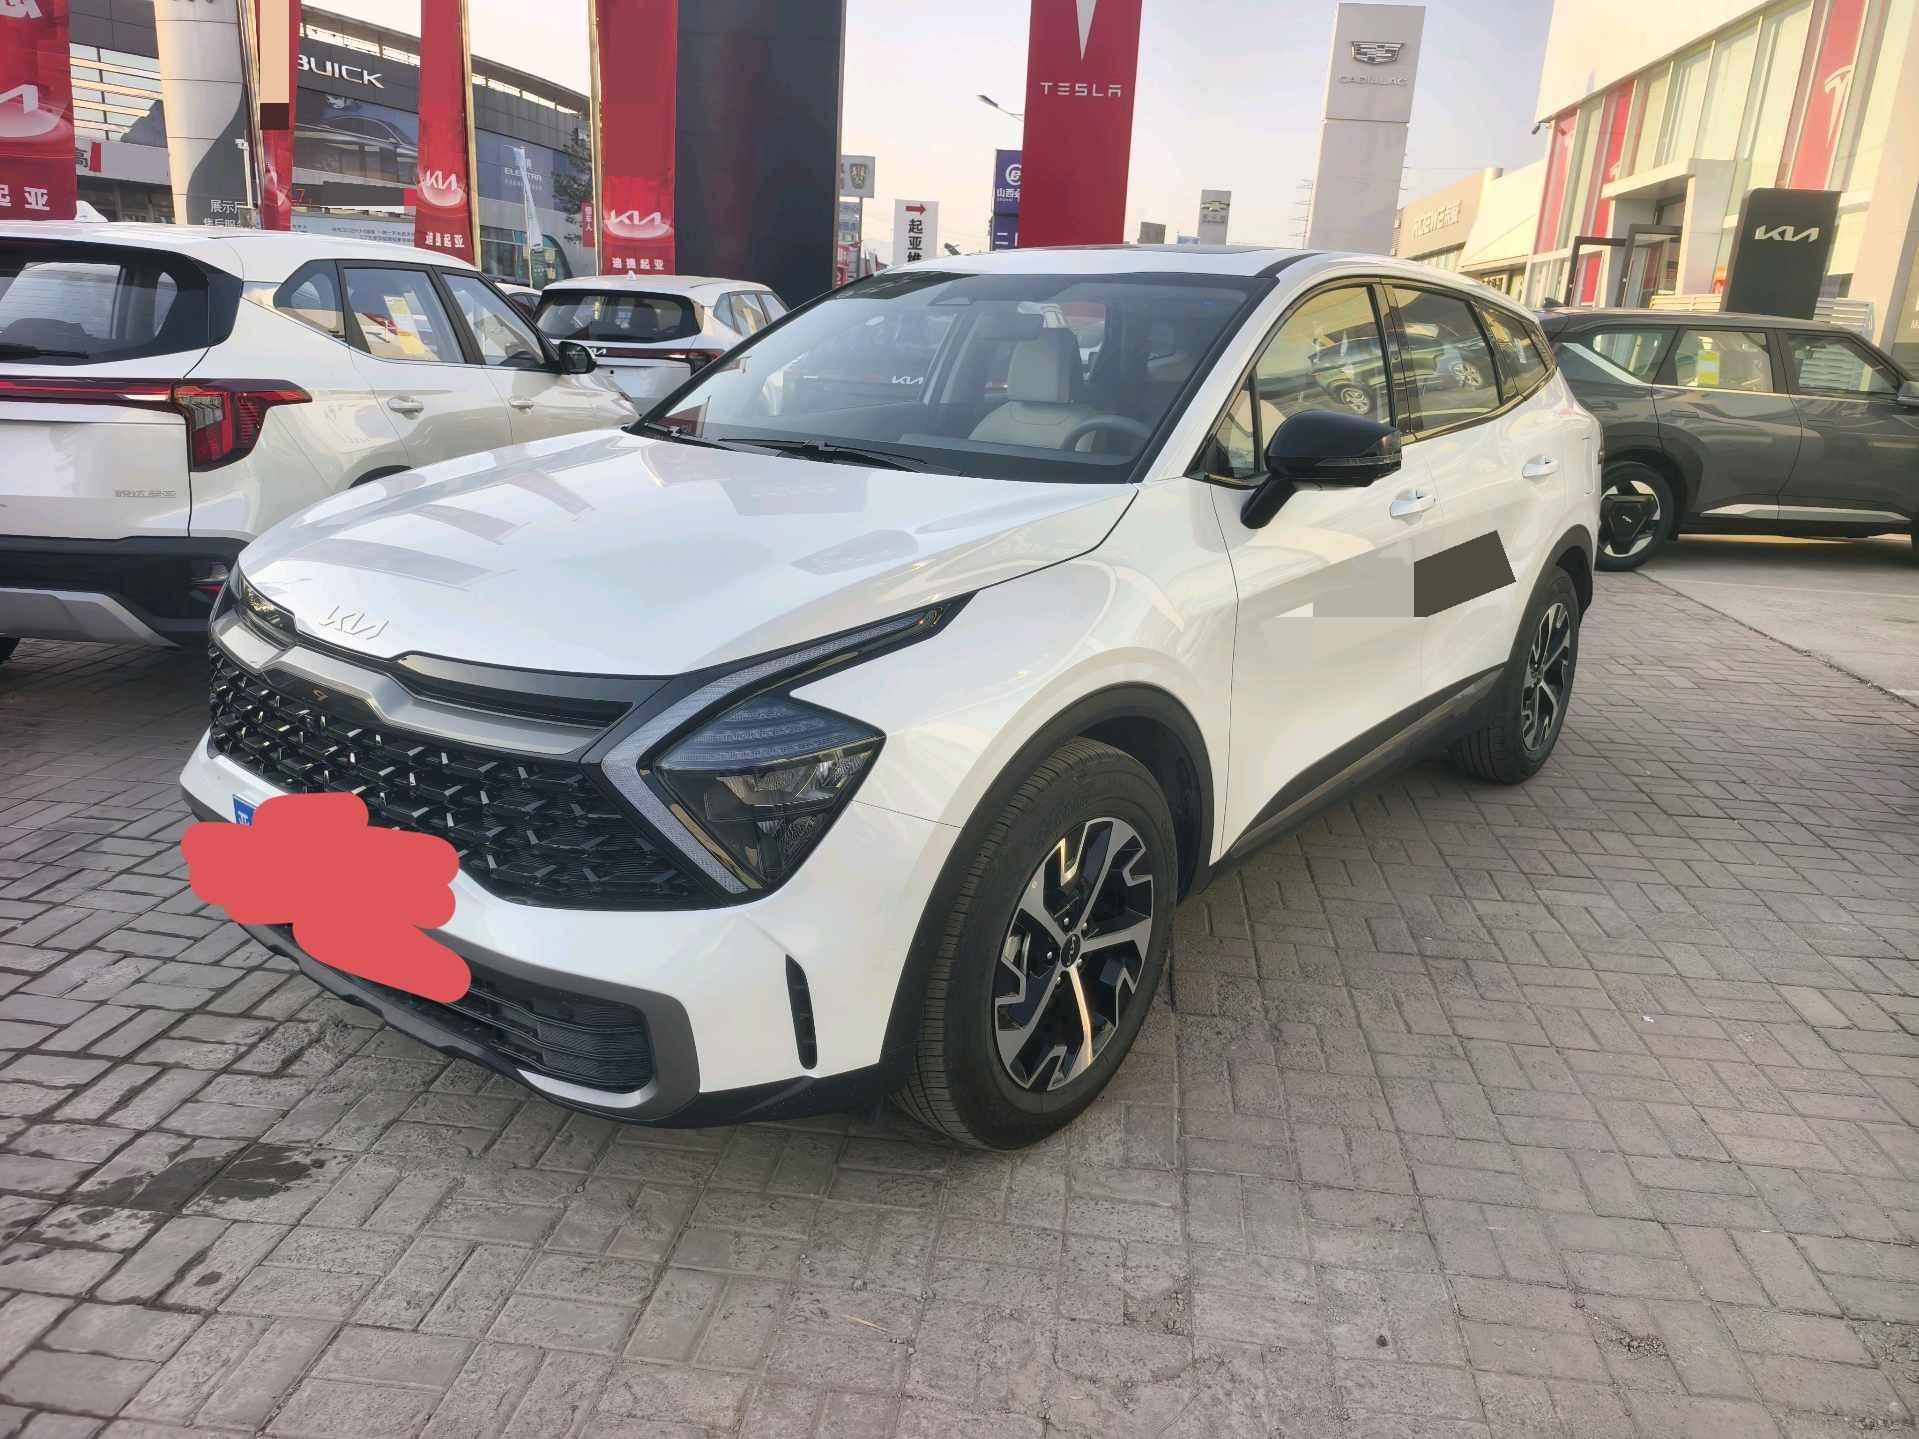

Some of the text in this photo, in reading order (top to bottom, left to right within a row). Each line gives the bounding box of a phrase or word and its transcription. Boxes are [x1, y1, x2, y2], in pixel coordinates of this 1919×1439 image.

[297, 54, 385, 89] BUICK
[1039, 82, 1123, 97] TESLA
[424, 168, 459, 191] KIA
[608, 208, 662, 225] KIA
[1754, 224, 1820, 243] KIA
[891, 375, 924, 385] KIA
[319, 605, 390, 641] KIA
